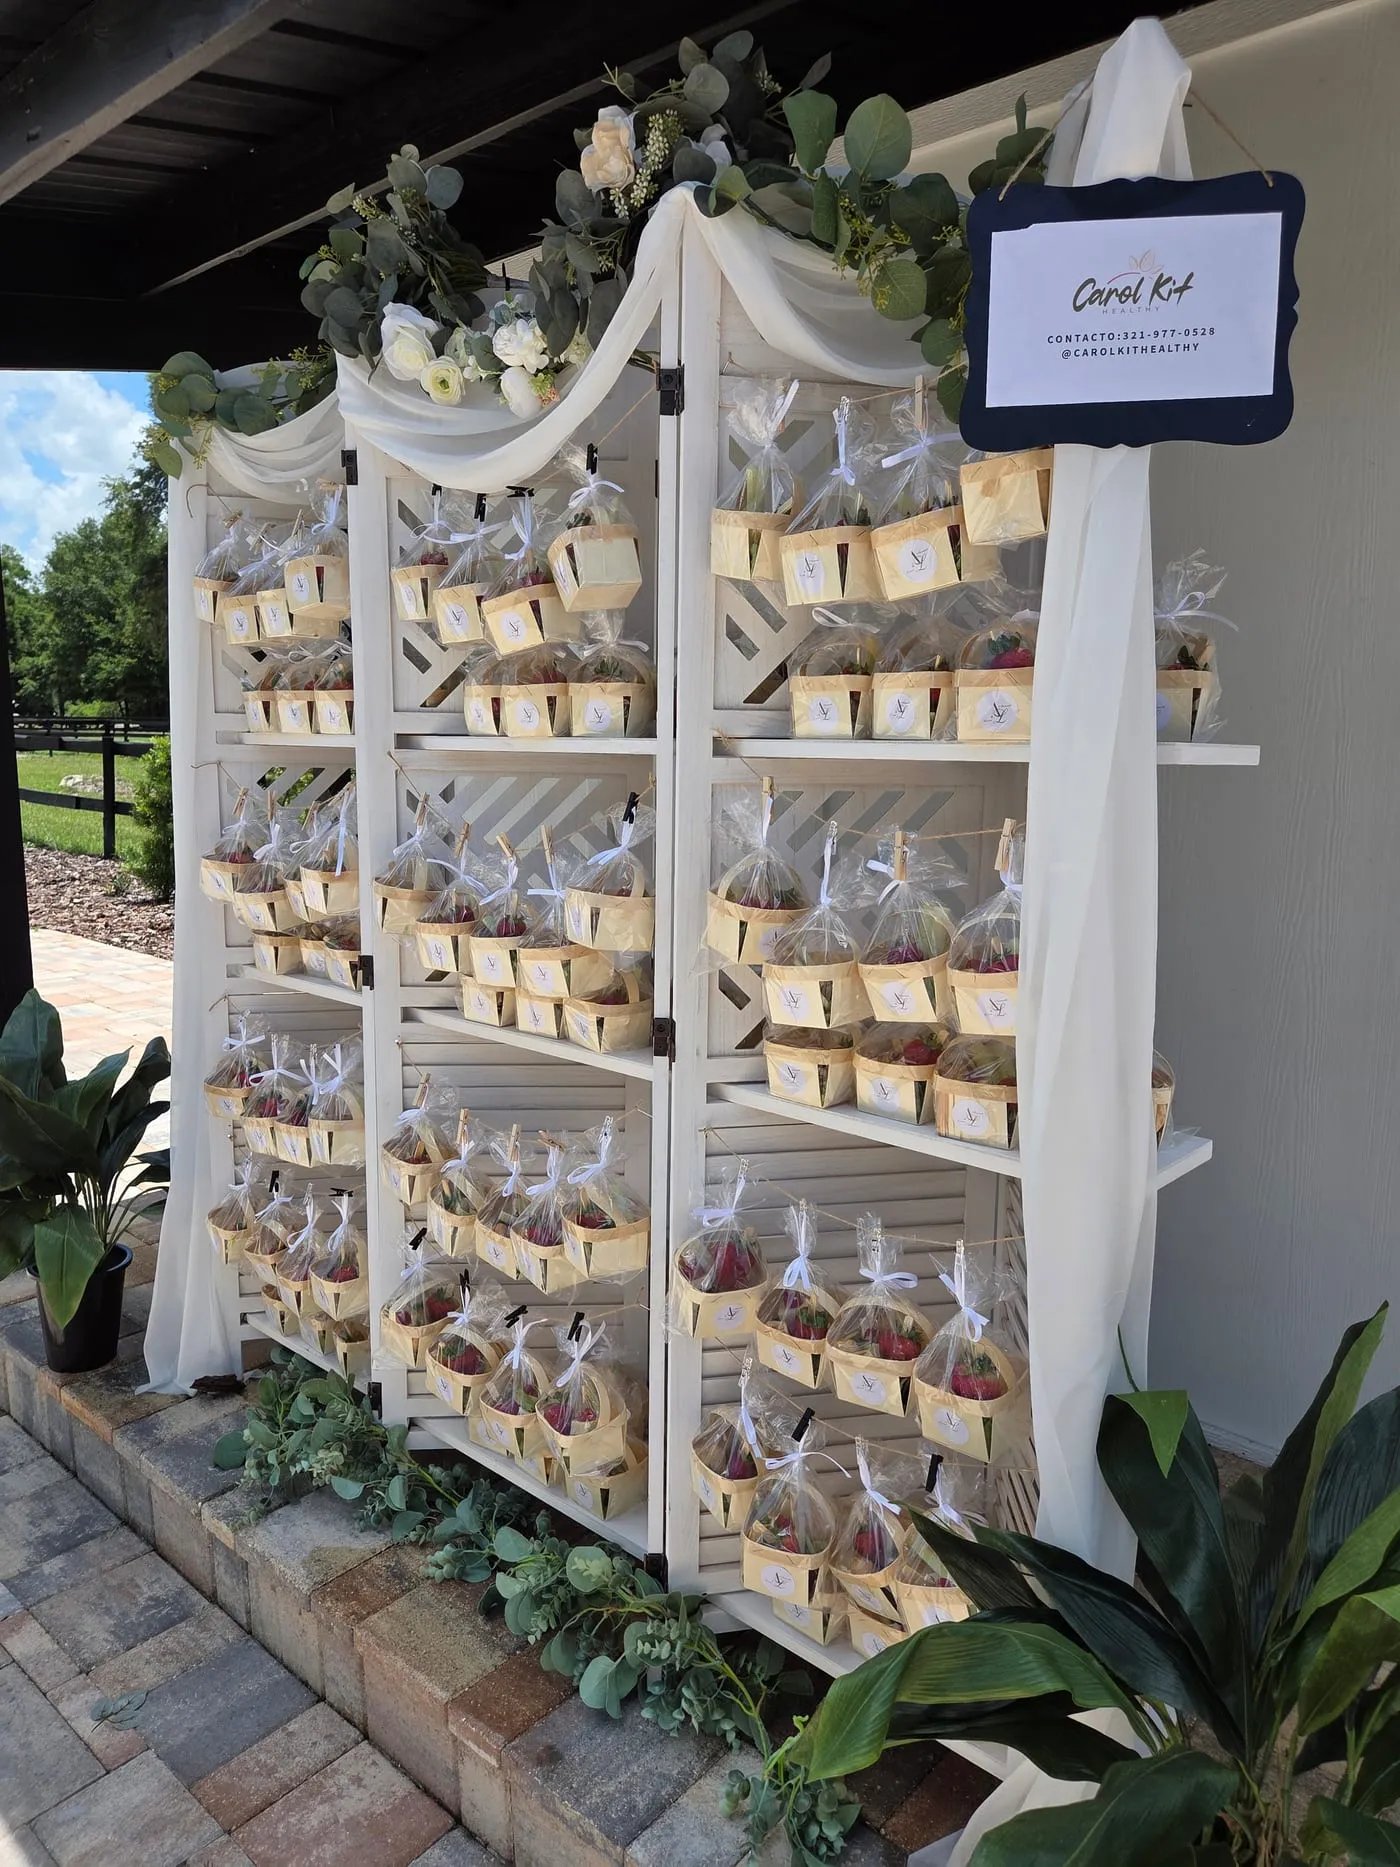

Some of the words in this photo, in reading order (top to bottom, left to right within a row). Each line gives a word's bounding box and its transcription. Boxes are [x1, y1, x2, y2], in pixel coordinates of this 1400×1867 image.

[1072, 277, 1145, 312] Carol
[1148, 271, 1195, 306] Kit
[1102, 306, 1161, 315] HEALTHY
[1047, 327, 1216, 345] CONTACTO:321-977-0528
[1061, 342, 1200, 360] @CAROLKITHEALTHY
